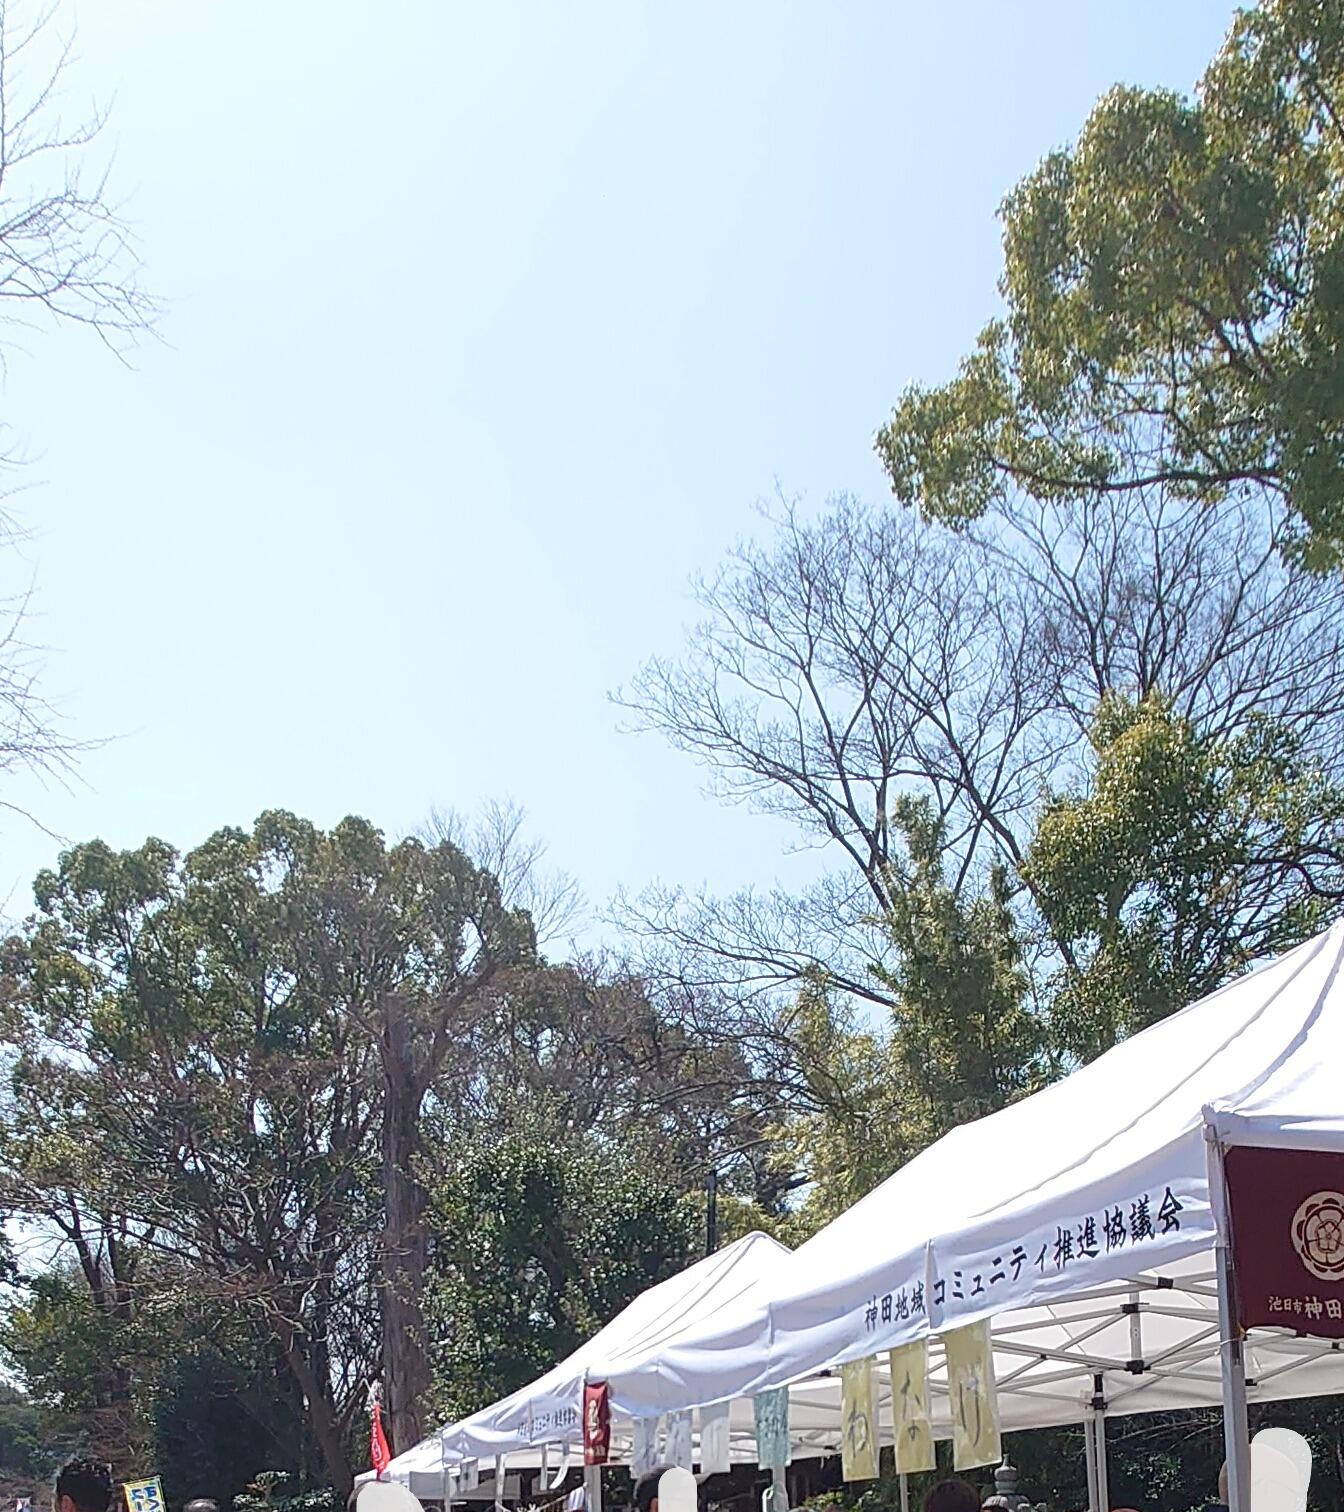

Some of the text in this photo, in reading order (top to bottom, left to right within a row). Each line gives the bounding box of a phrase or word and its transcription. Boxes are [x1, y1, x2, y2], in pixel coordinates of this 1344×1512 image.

[864, 1186, 1184, 1333] 神田地域コミュニティ推進協議会
